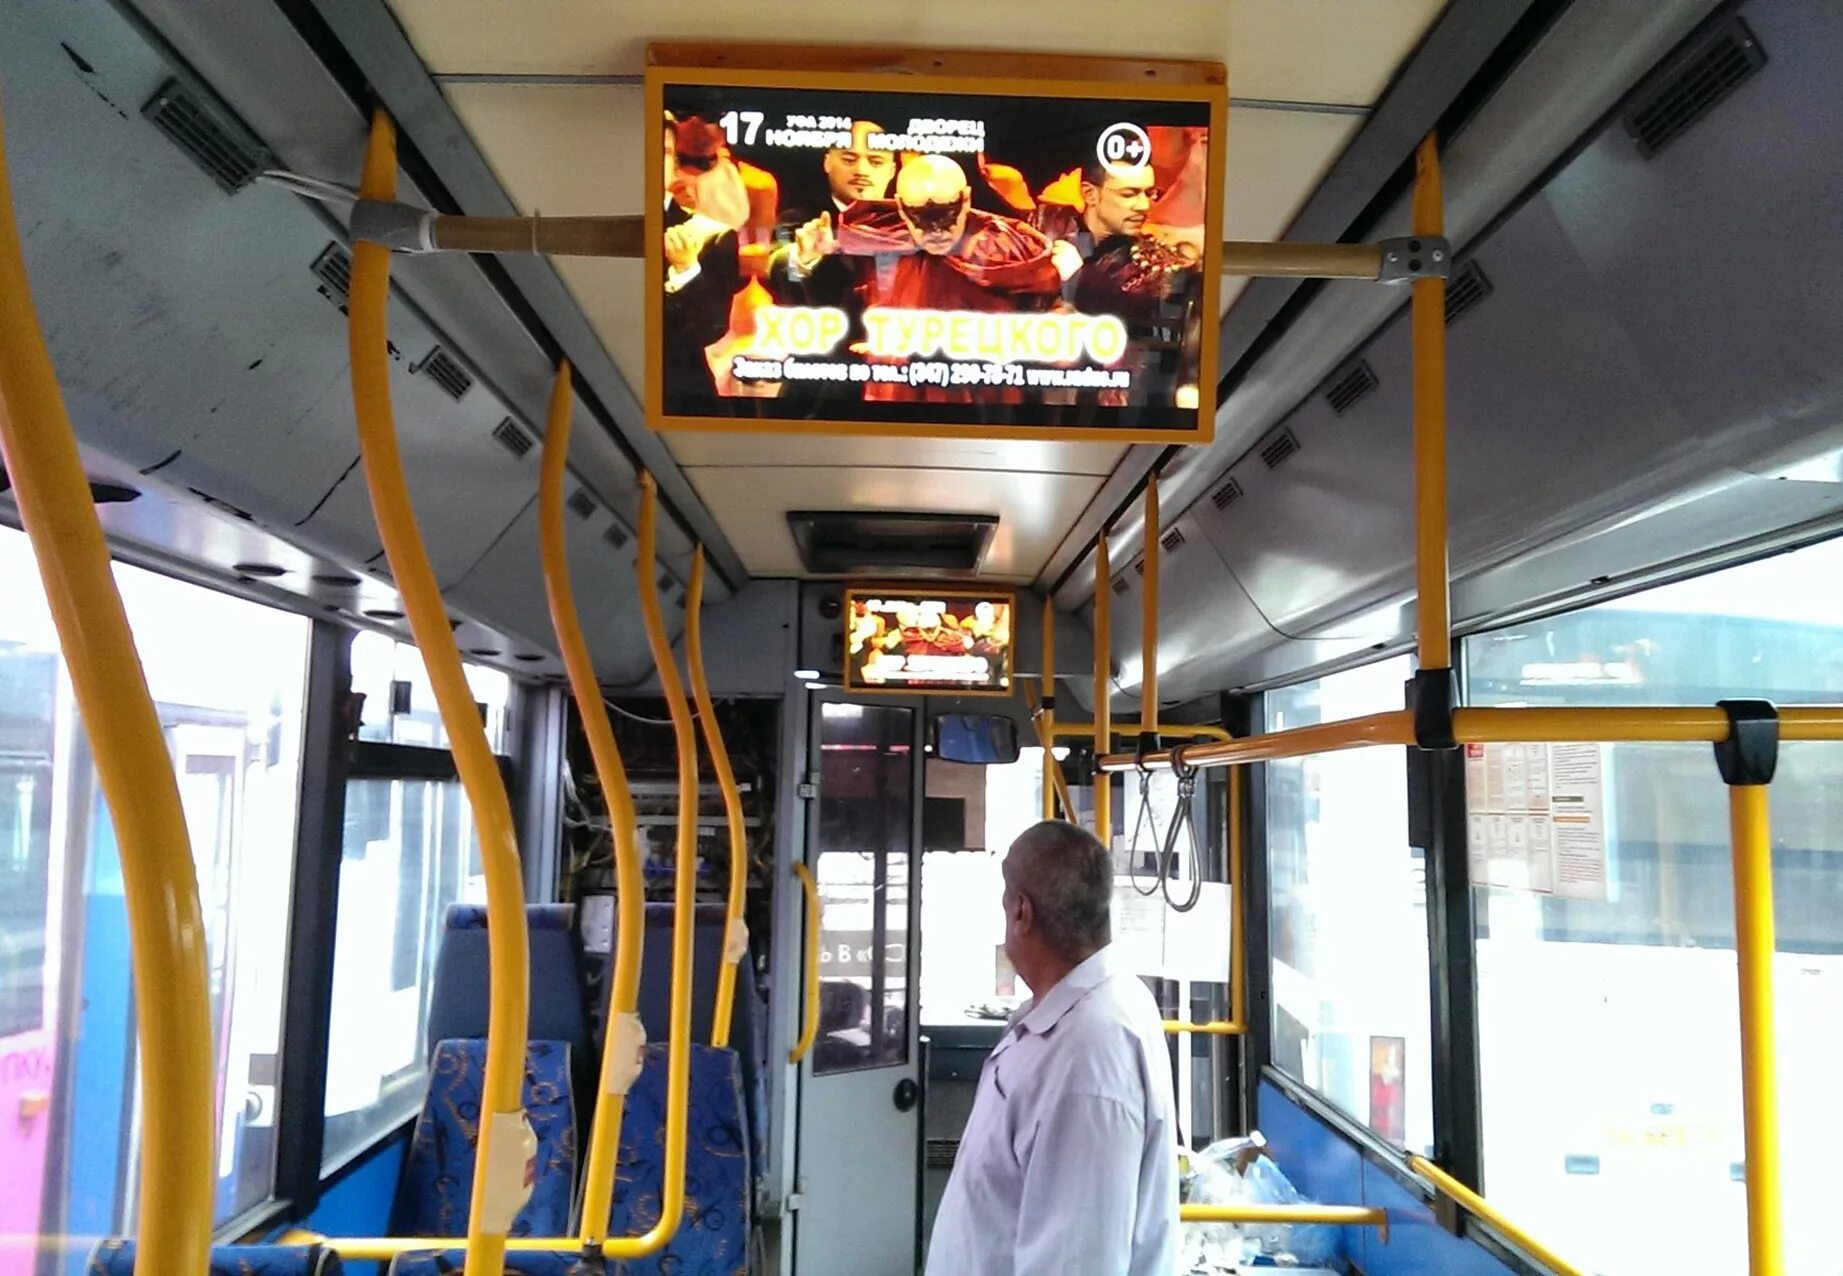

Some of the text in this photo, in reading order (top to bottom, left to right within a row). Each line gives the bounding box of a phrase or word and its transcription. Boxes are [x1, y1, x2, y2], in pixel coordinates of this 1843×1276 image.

[719, 111, 764, 145] 17
[907, 118, 985, 138] ДВОРЕЦ
[1107, 134, 1144, 160] 0+
[757, 309, 1125, 361] ХОР ТУРЕЦКОГО
